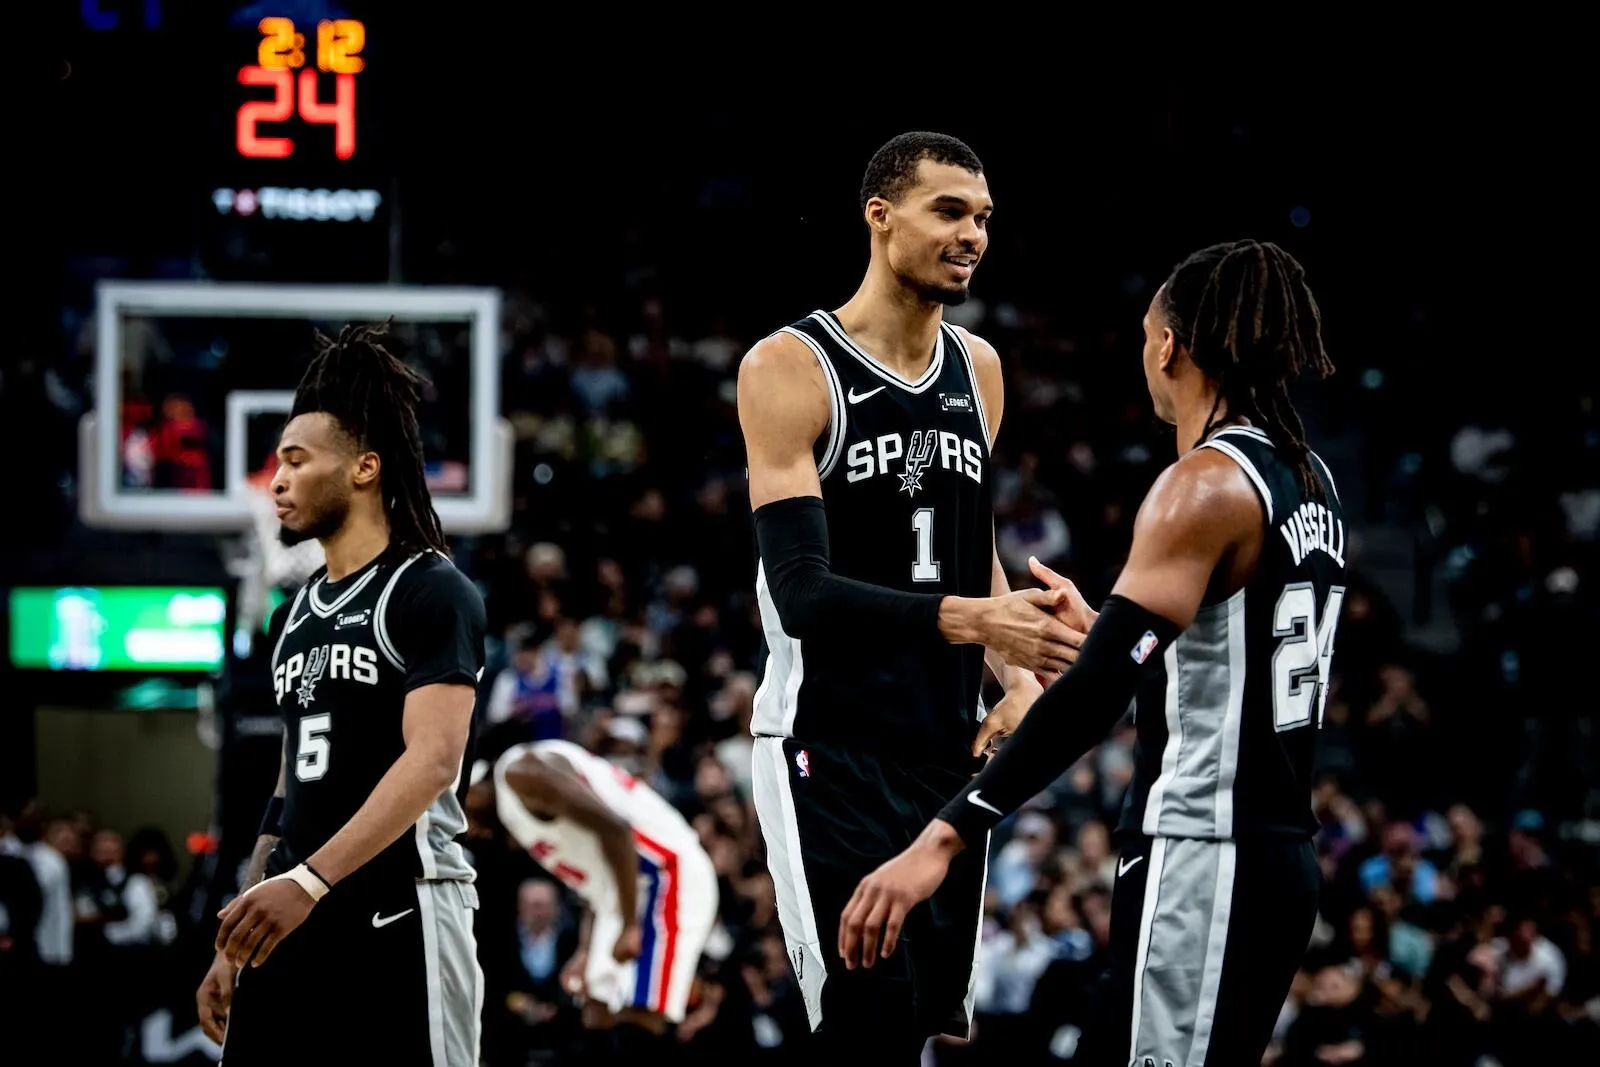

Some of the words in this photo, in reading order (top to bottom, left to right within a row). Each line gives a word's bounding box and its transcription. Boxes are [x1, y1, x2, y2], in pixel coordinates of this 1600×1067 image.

[258, 16, 366, 73] 2:12
[237, 66, 355, 160] 24
[945, 398, 969, 407] LEDGER
[847, 430, 982, 497] SPURS
[912, 507, 941, 582] 1
[1280, 502, 1345, 568] VASSELL
[274, 643, 379, 708] SPURS
[1271, 581, 1346, 733] 24
[296, 712, 332, 782] 5
